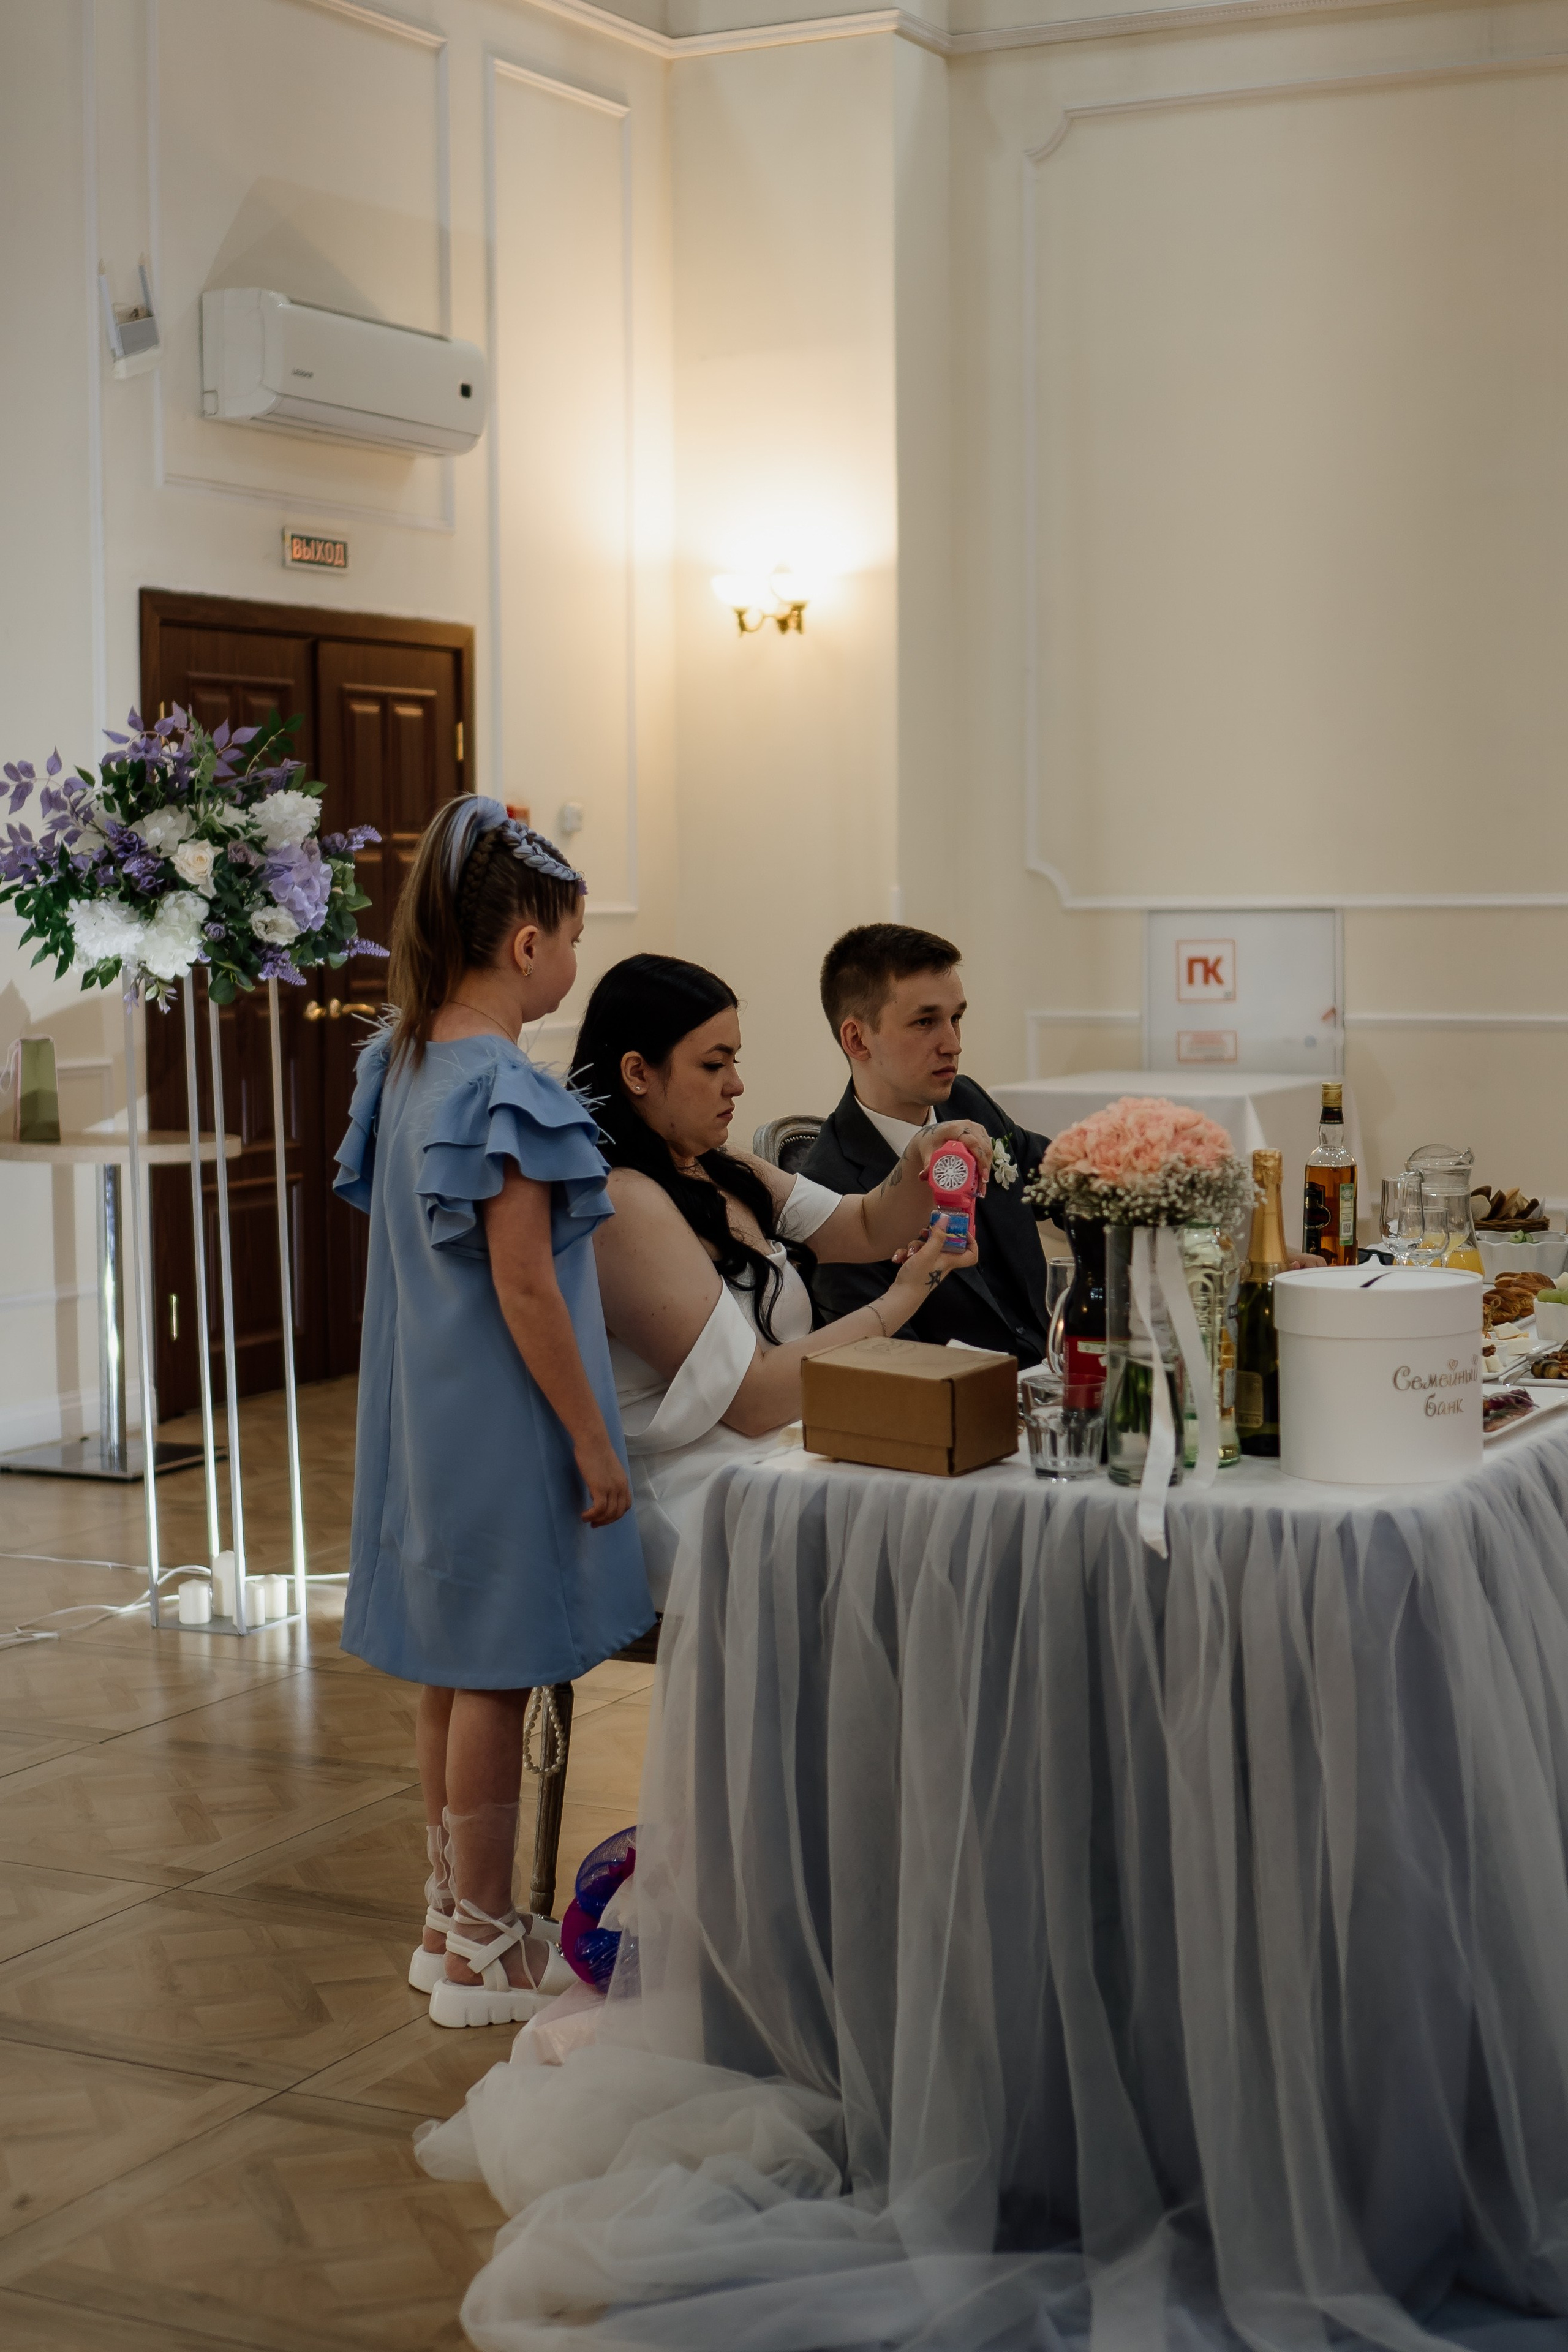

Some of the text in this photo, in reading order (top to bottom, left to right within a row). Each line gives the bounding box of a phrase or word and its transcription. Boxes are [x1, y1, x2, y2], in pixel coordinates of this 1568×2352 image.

[292, 537, 345, 567] ВЫХОД
[1187, 956, 1224, 986] ПК
[1393, 1355, 1479, 1391] Семейный
[1425, 1393, 1464, 1417] банк
